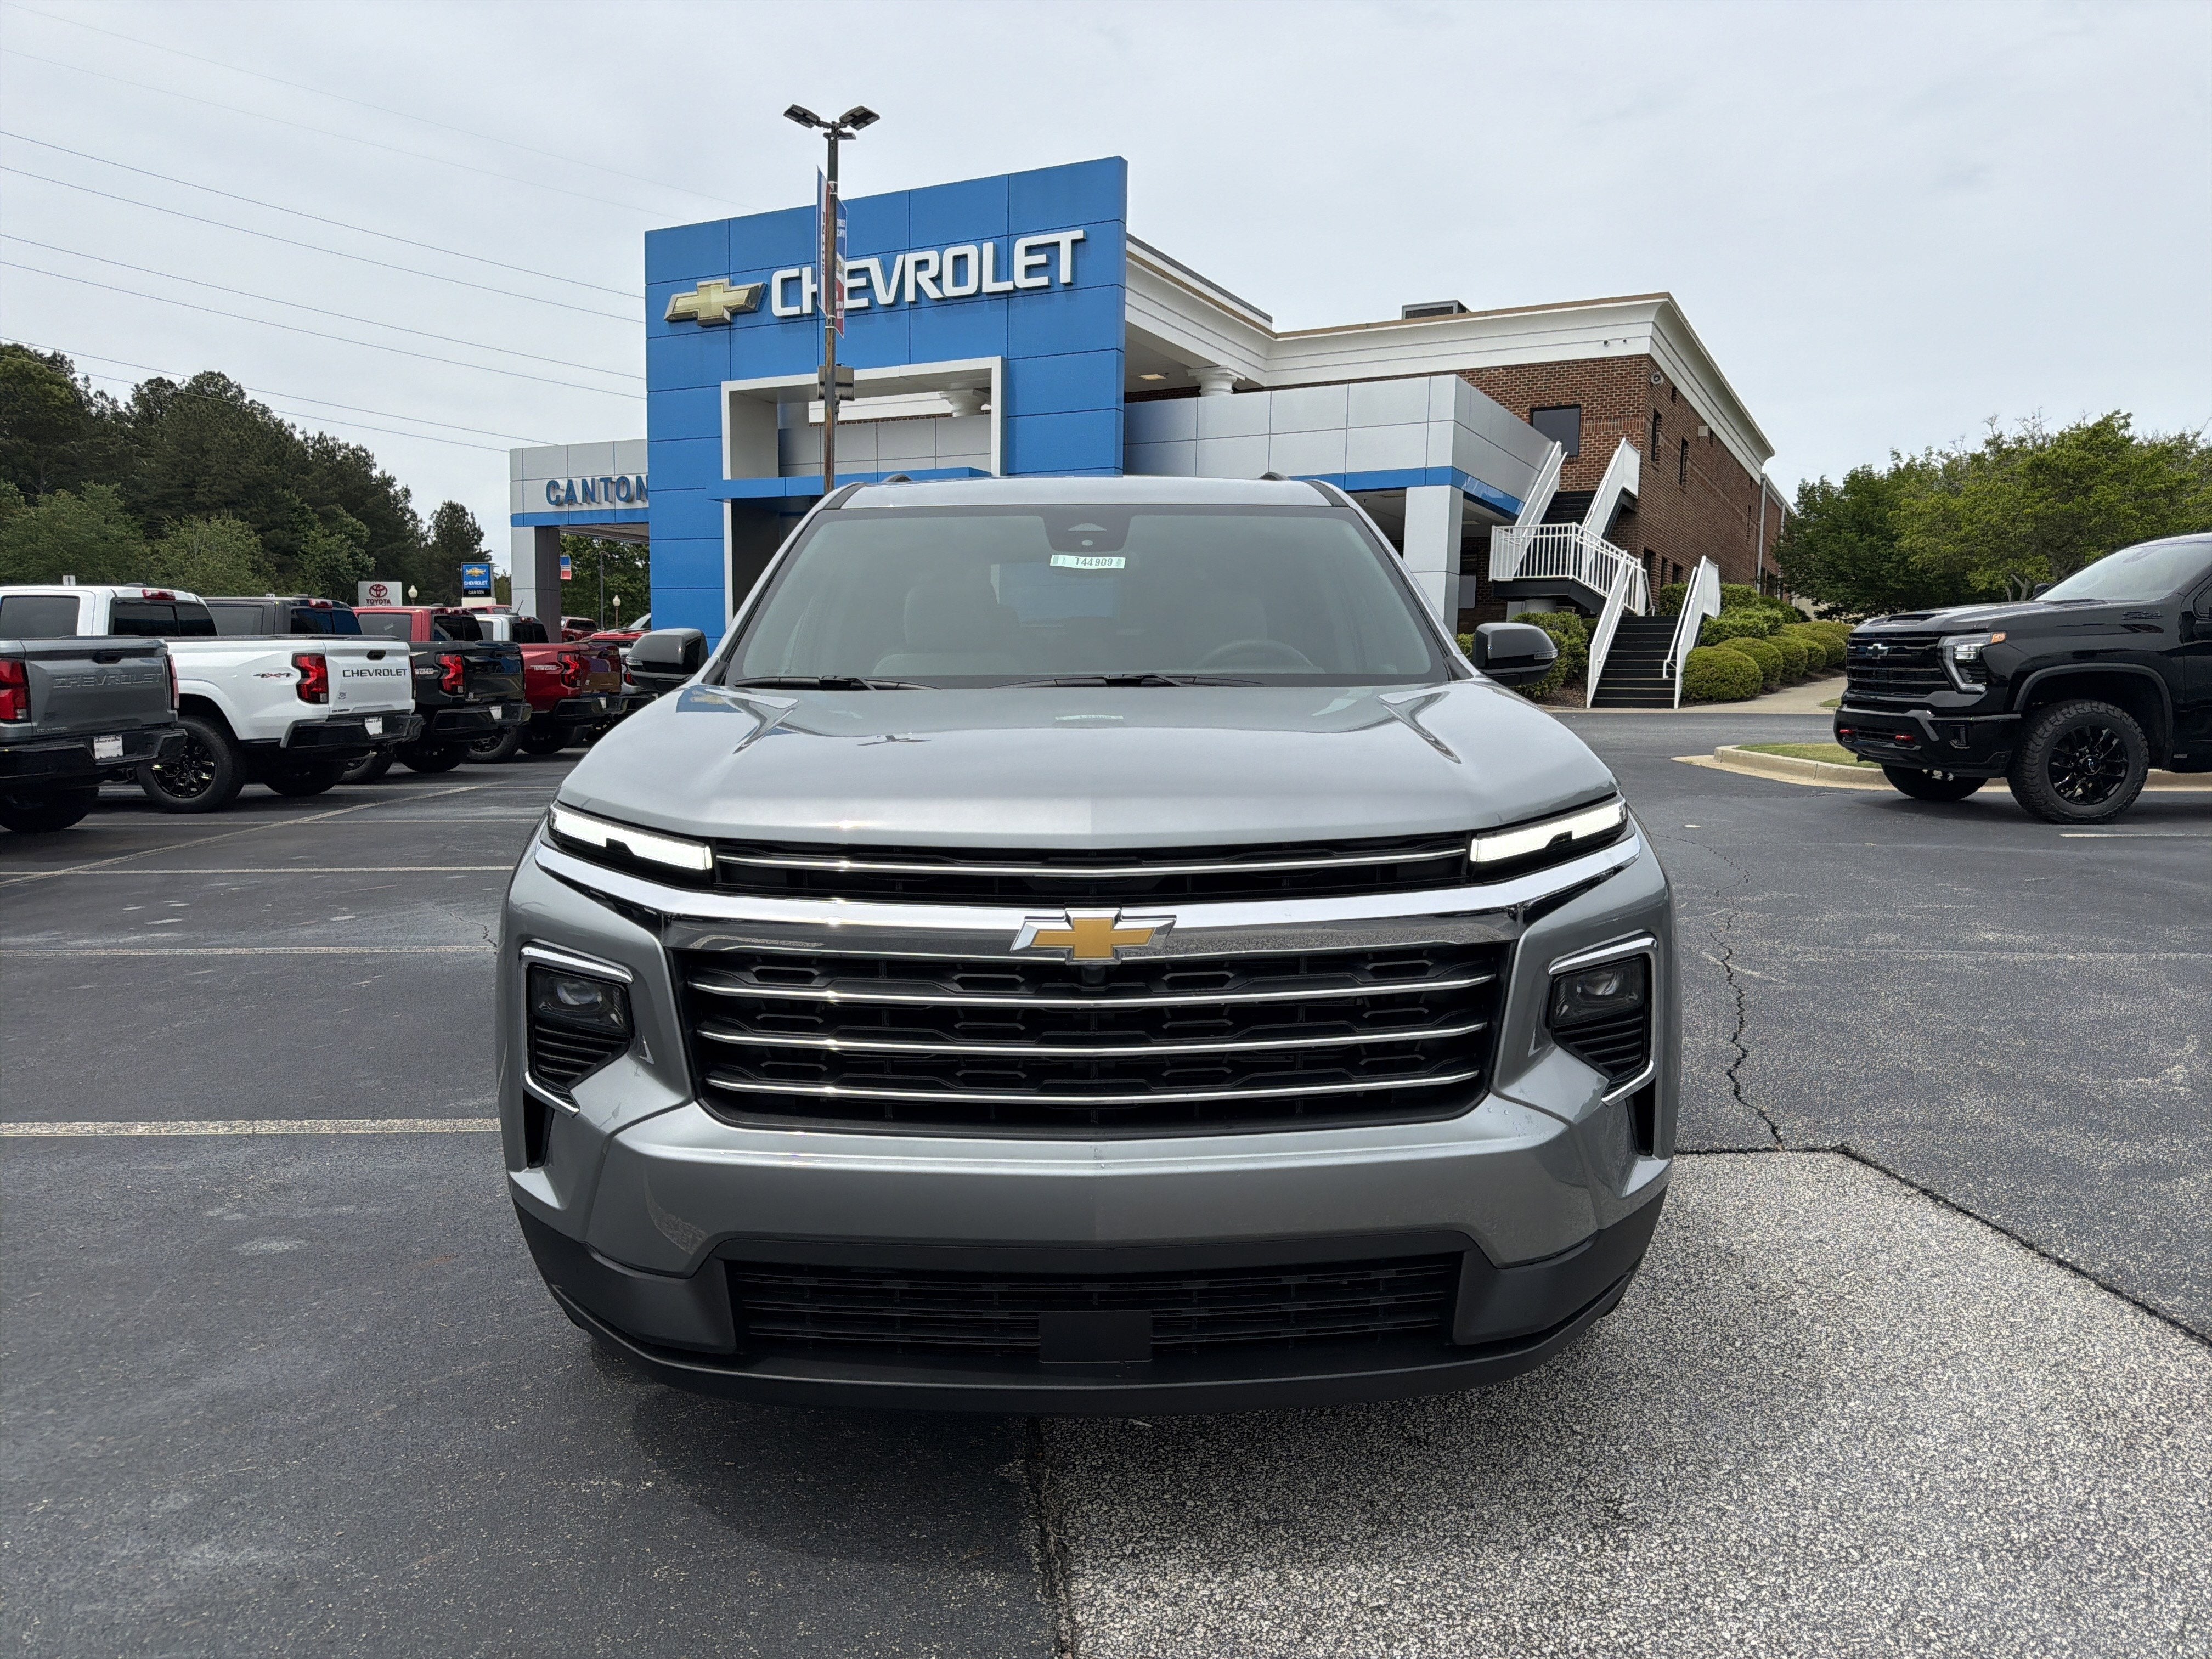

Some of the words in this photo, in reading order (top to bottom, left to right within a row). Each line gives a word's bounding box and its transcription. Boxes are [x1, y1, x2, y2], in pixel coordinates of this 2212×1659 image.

[771, 229, 1085, 317] CHEVROLET
[546, 475, 648, 506] CANTON
[1075, 557, 1113, 567] T44909
[53, 673, 162, 689] CHEVROLET
[342, 668, 408, 678] CHEVROLET
